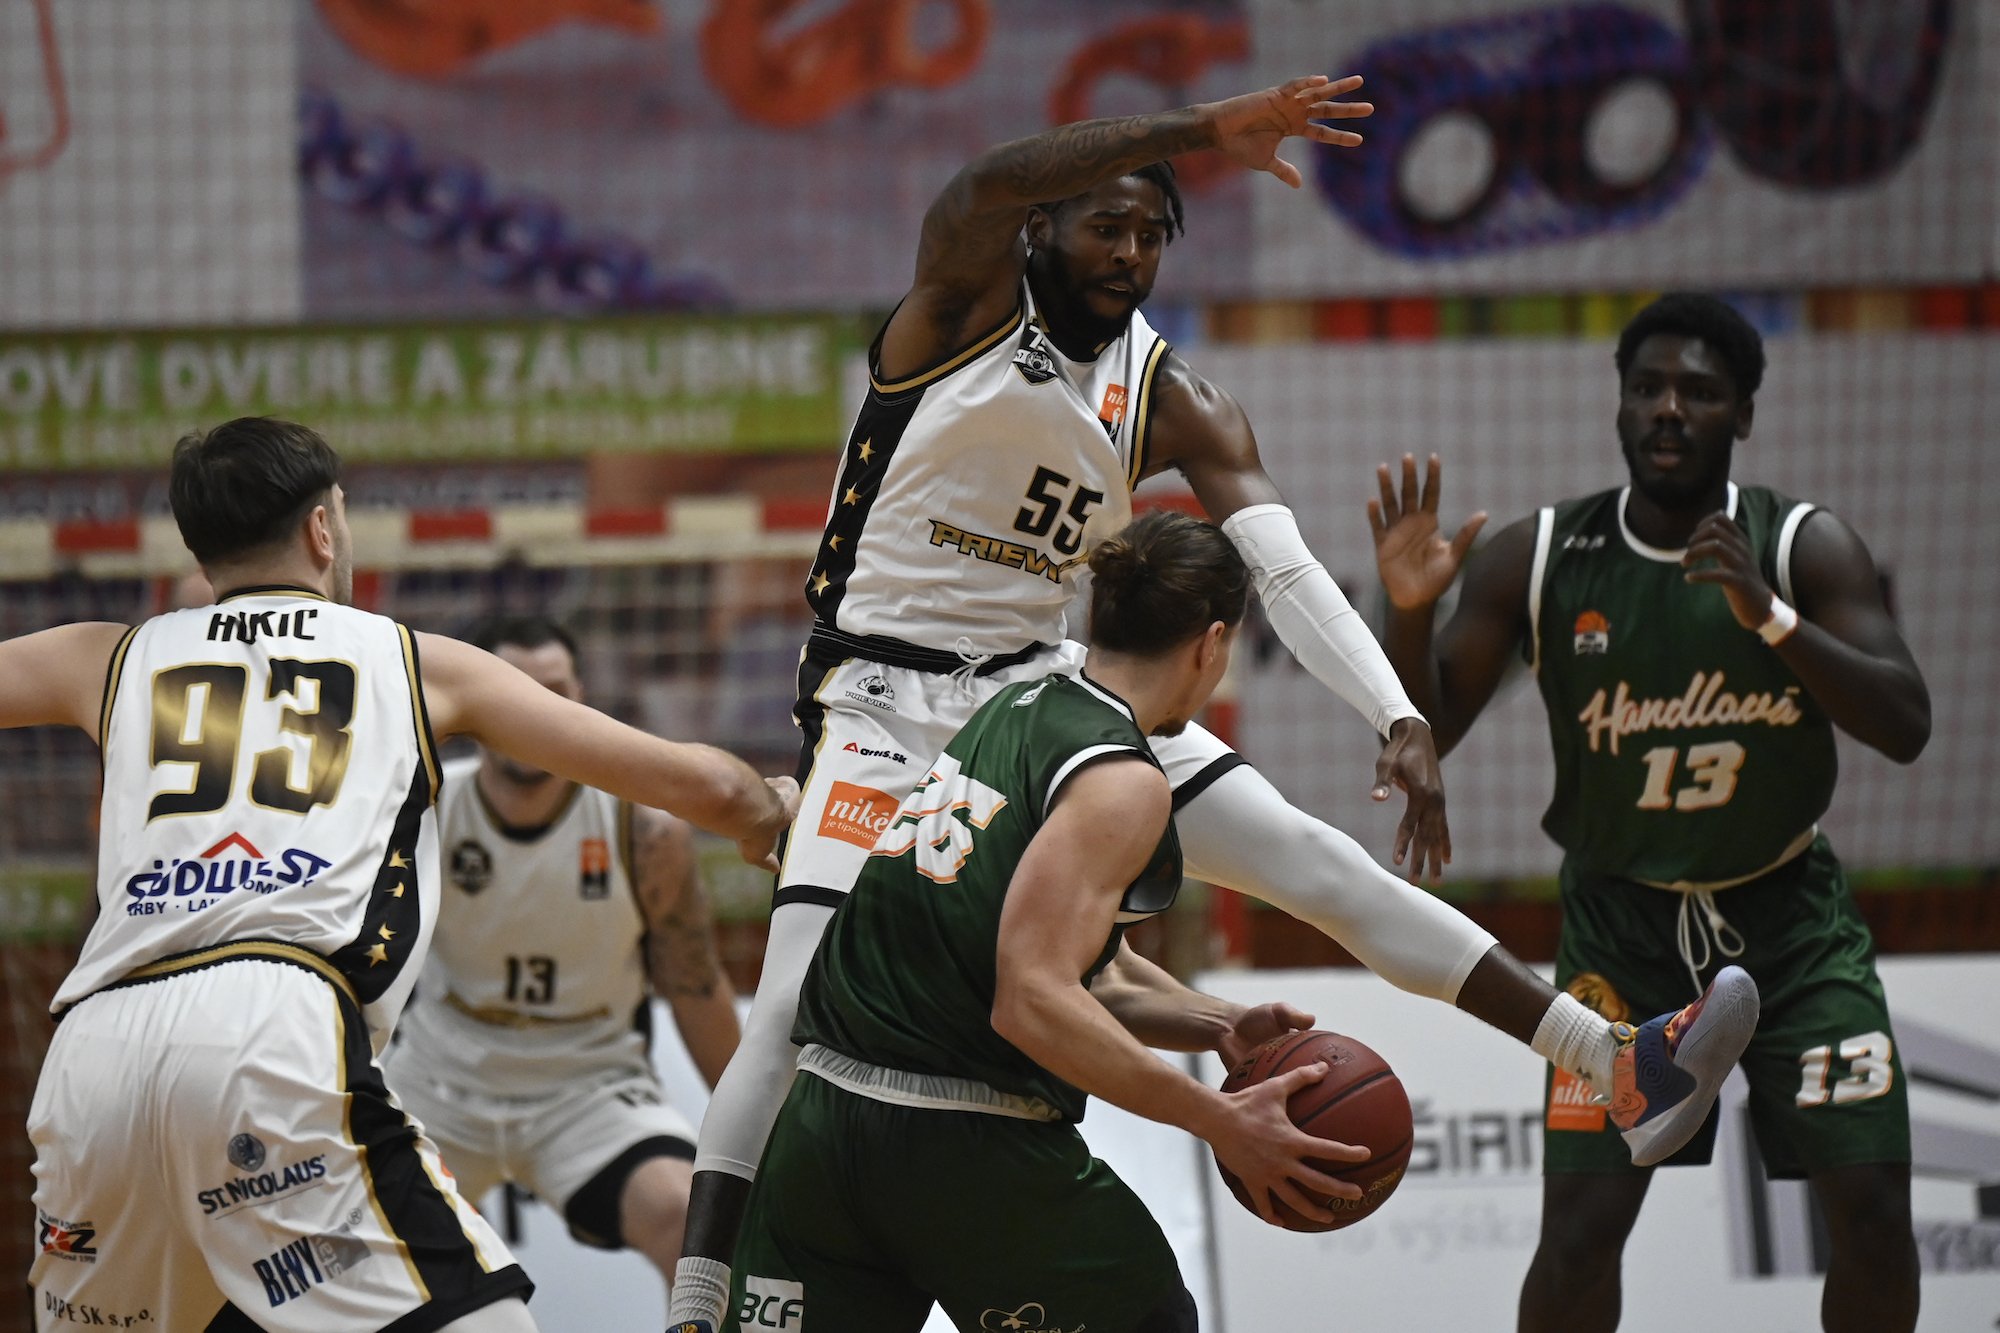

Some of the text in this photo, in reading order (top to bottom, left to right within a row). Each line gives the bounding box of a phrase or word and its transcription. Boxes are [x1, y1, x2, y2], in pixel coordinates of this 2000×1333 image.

[411, 335, 468, 406] A
[1013, 464, 1104, 555] 55
[145, 656, 360, 826] 93
[1635, 740, 1747, 811] 13
[829, 797, 890, 834] niké
[504, 956, 556, 1005] 13
[1795, 1030, 1894, 1109] 13
[79, 1304, 104, 1326] SK
[738, 1292, 804, 1329] BCF
